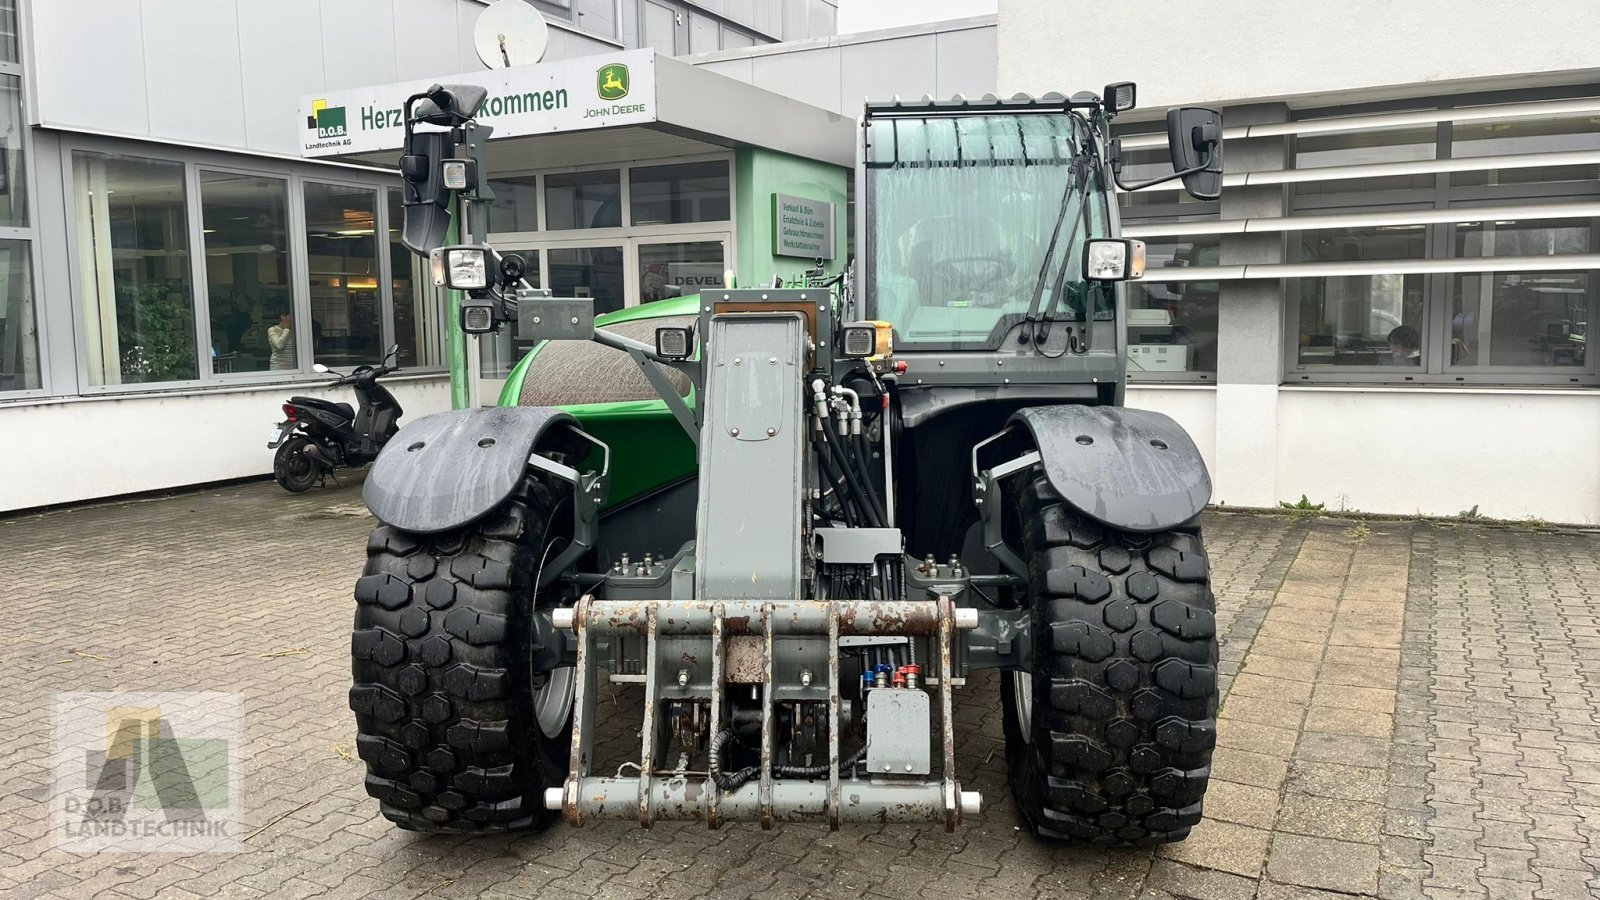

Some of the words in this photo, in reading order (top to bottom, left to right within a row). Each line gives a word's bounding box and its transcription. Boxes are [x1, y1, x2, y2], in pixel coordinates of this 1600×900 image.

[474, 88, 568, 119] kommen
[583, 108, 610, 118] JOHN
[612, 104, 646, 115] DEERE
[319, 125, 347, 138] D.O.B.
[305, 140, 341, 150] Landtechnik
[343, 138, 352, 146] AG
[783, 202, 799, 213] Verkauf
[783, 214, 804, 226] Ersatzteile
[675, 276, 725, 286] DEVEL
